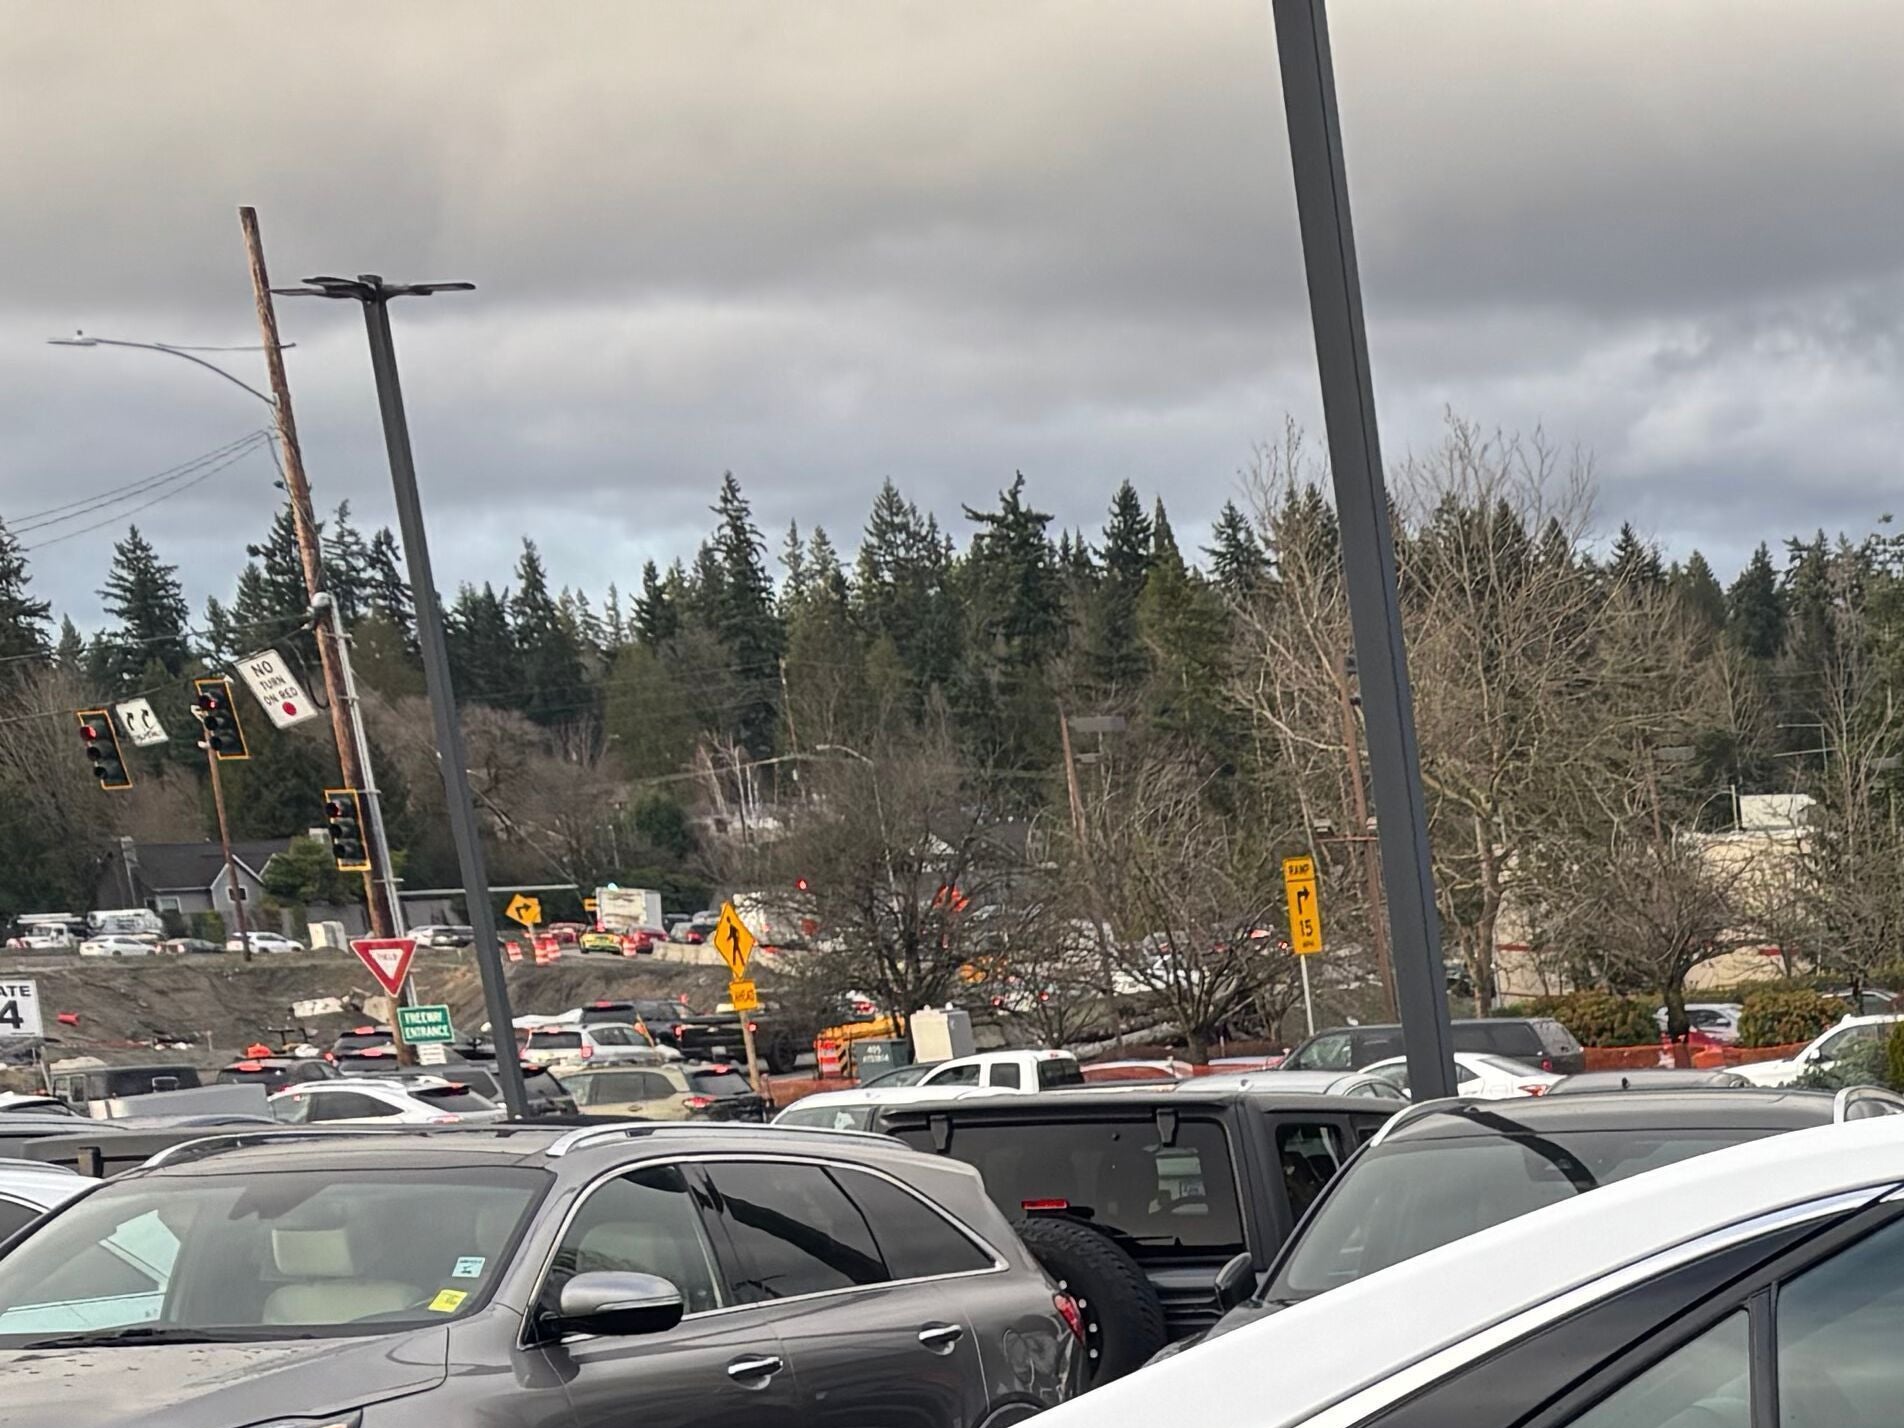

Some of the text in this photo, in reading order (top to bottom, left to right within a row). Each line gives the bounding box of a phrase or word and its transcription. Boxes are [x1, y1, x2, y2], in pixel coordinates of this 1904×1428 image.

[250, 660, 274, 678] NO
[259, 676, 287, 692] TURN
[263, 686, 299, 707] ON RED
[1299, 918, 1314, 937] 15
[405, 1025, 450, 1039] ENTRANCE
